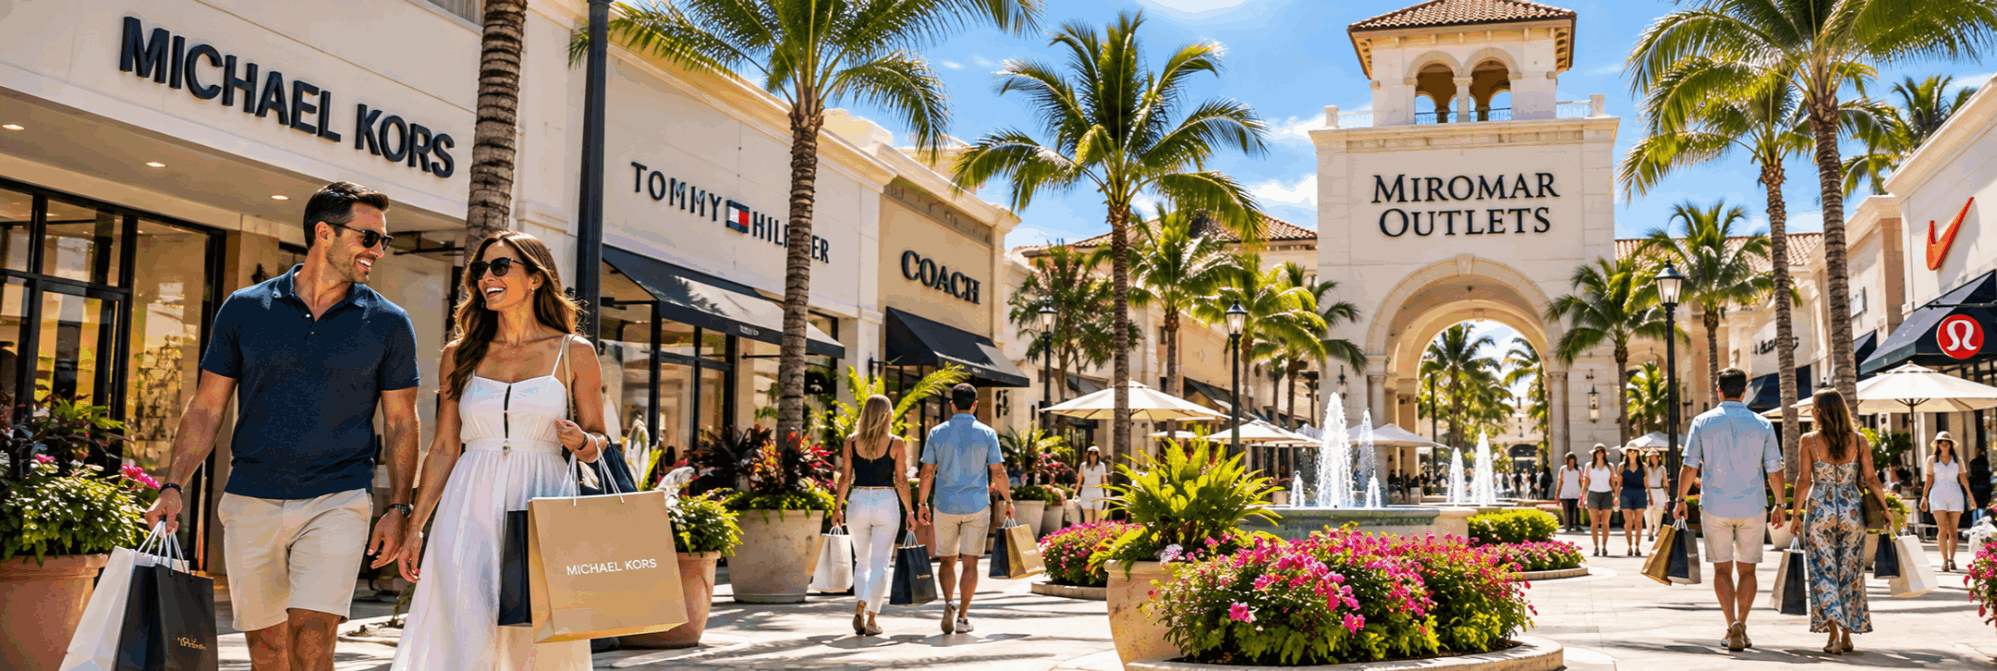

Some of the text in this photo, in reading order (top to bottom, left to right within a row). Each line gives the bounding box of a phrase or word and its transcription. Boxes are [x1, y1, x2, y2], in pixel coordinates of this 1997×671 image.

[119, 16, 455, 179] MICHAEL KORS
[1371, 172, 1560, 204] MIROMAR
[631, 161, 829, 264] TOMMY HILFER
[1379, 207, 1551, 237] OUTLETS
[901, 250, 981, 305] COACH
[566, 558, 657, 575] MICHAEL KORS
